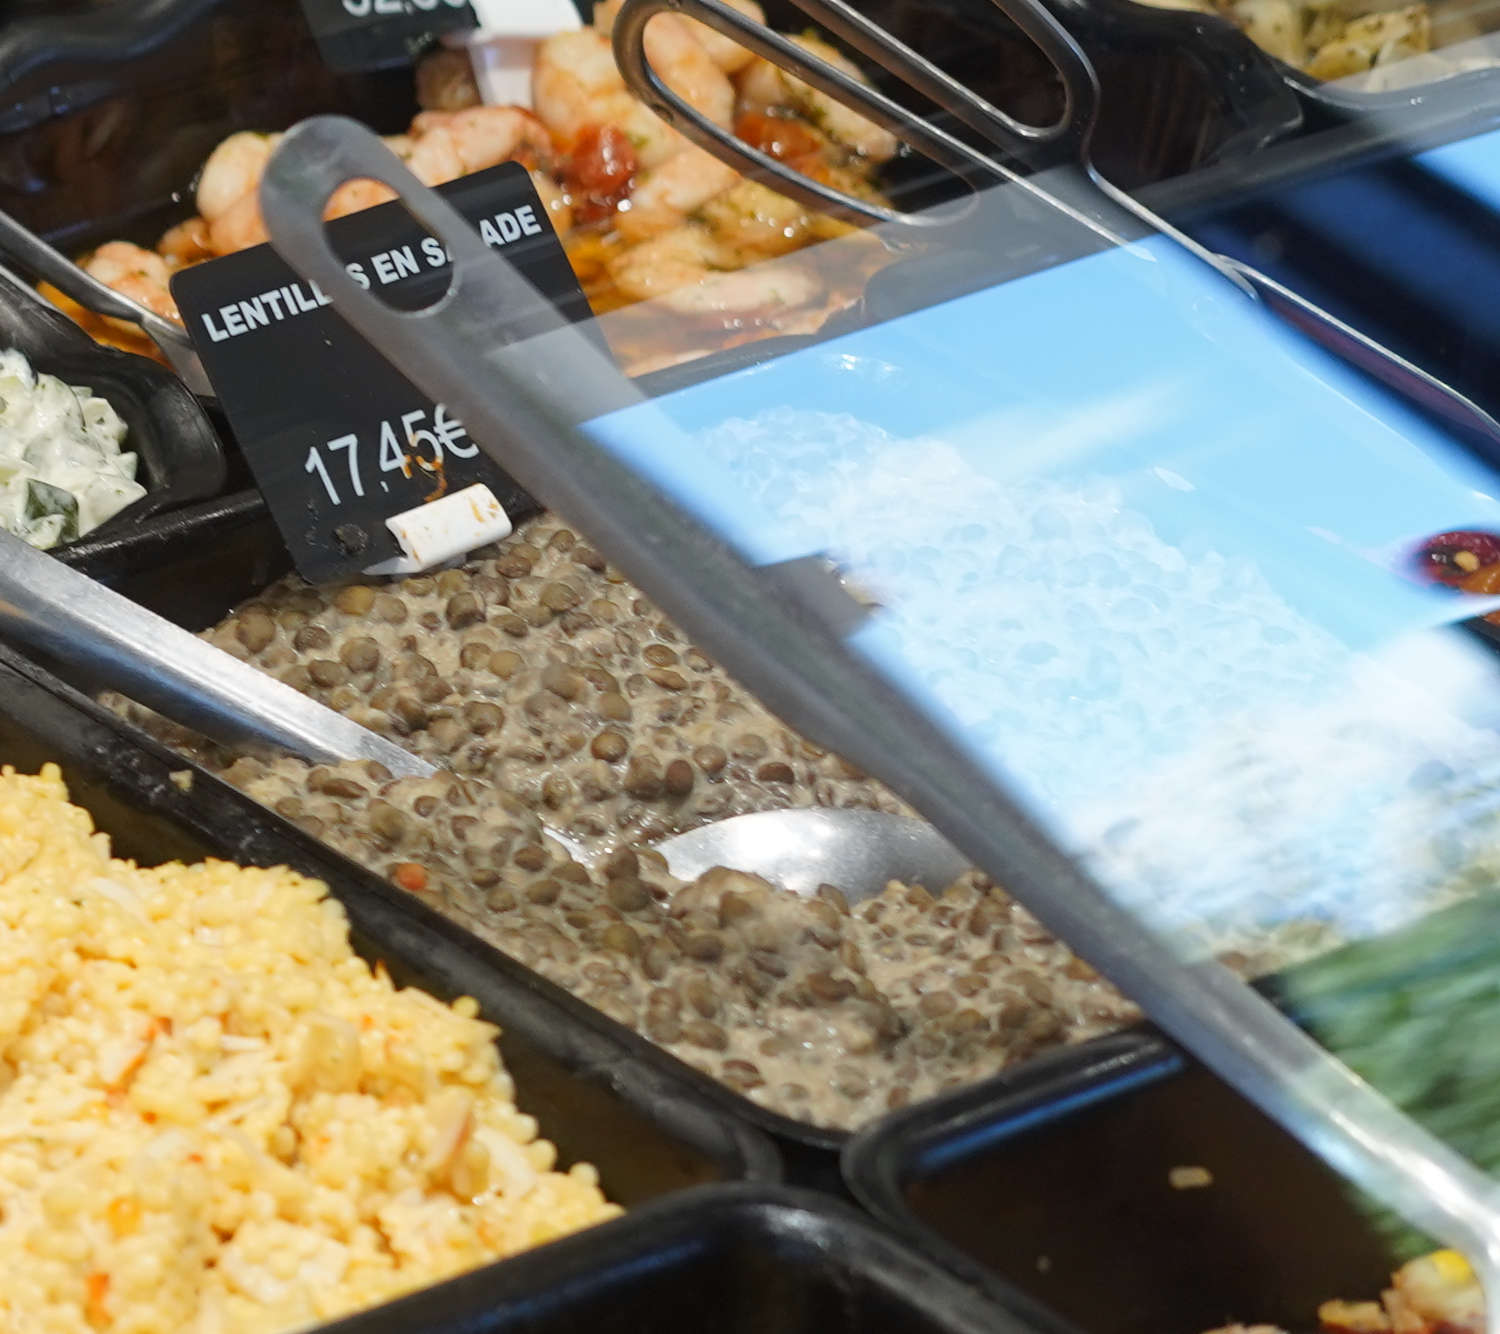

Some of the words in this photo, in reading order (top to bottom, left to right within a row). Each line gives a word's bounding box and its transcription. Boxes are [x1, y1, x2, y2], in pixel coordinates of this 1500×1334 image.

[201, 263, 371, 343] LENTILLS
[370, 245, 421, 285] EN
[420, 204, 543, 267] SADE
[304, 402, 480, 505] 17,45€
